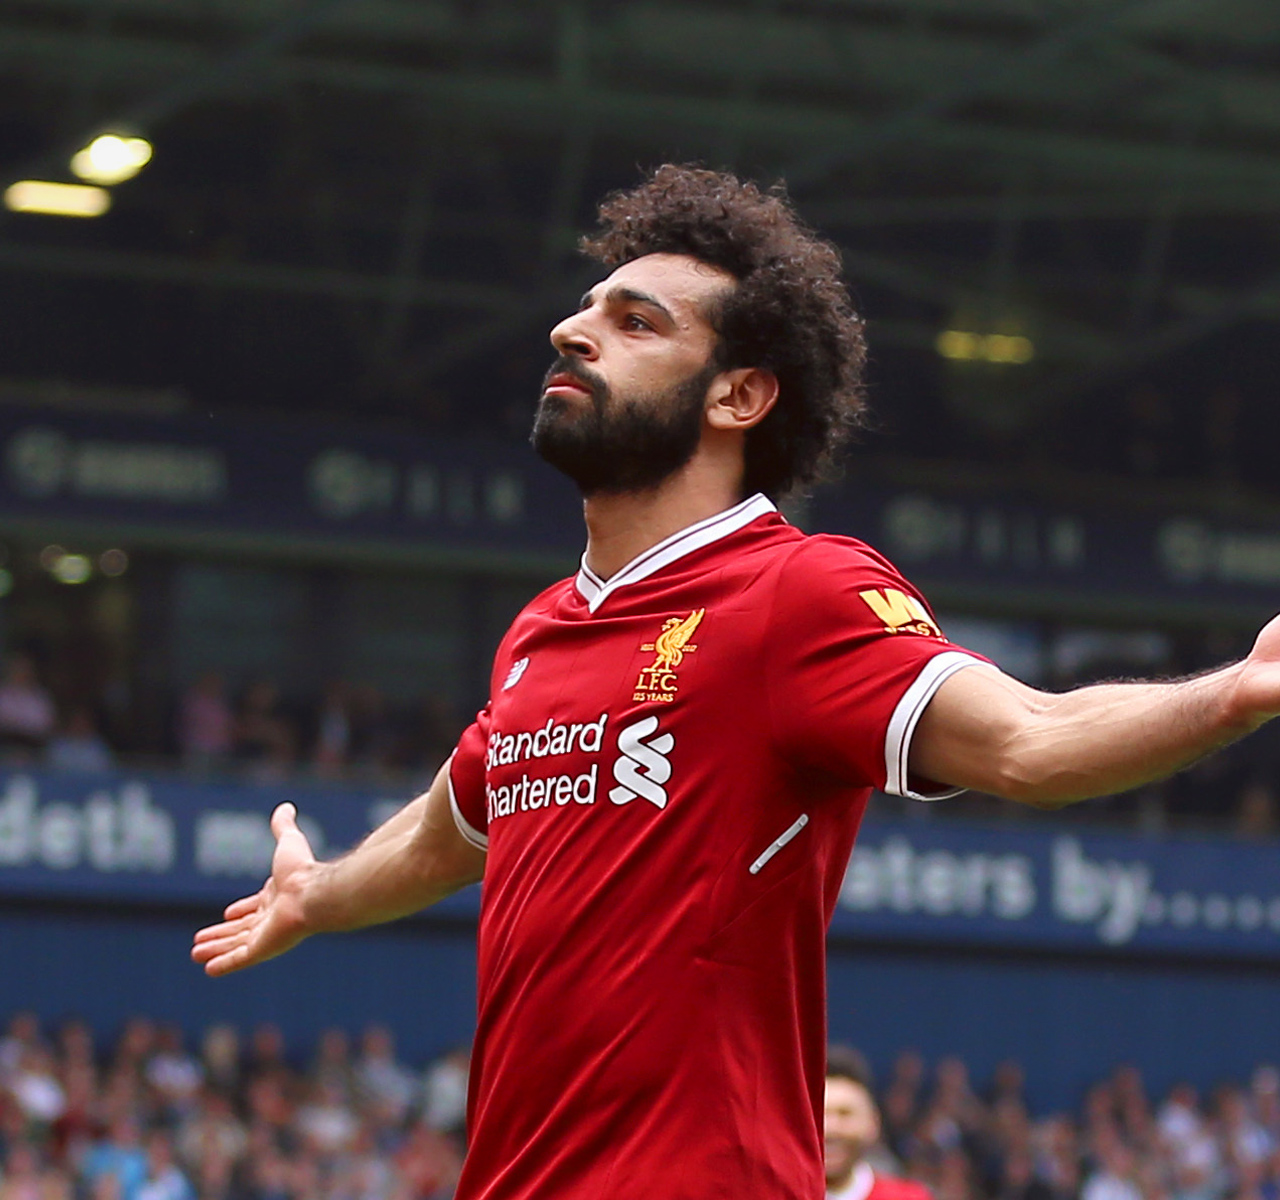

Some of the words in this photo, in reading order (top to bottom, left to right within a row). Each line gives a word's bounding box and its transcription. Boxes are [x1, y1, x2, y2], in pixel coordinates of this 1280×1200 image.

[647, 693, 674, 702] YEARS
[485, 763, 598, 824] hartered
[838, 832, 1038, 920] aters
